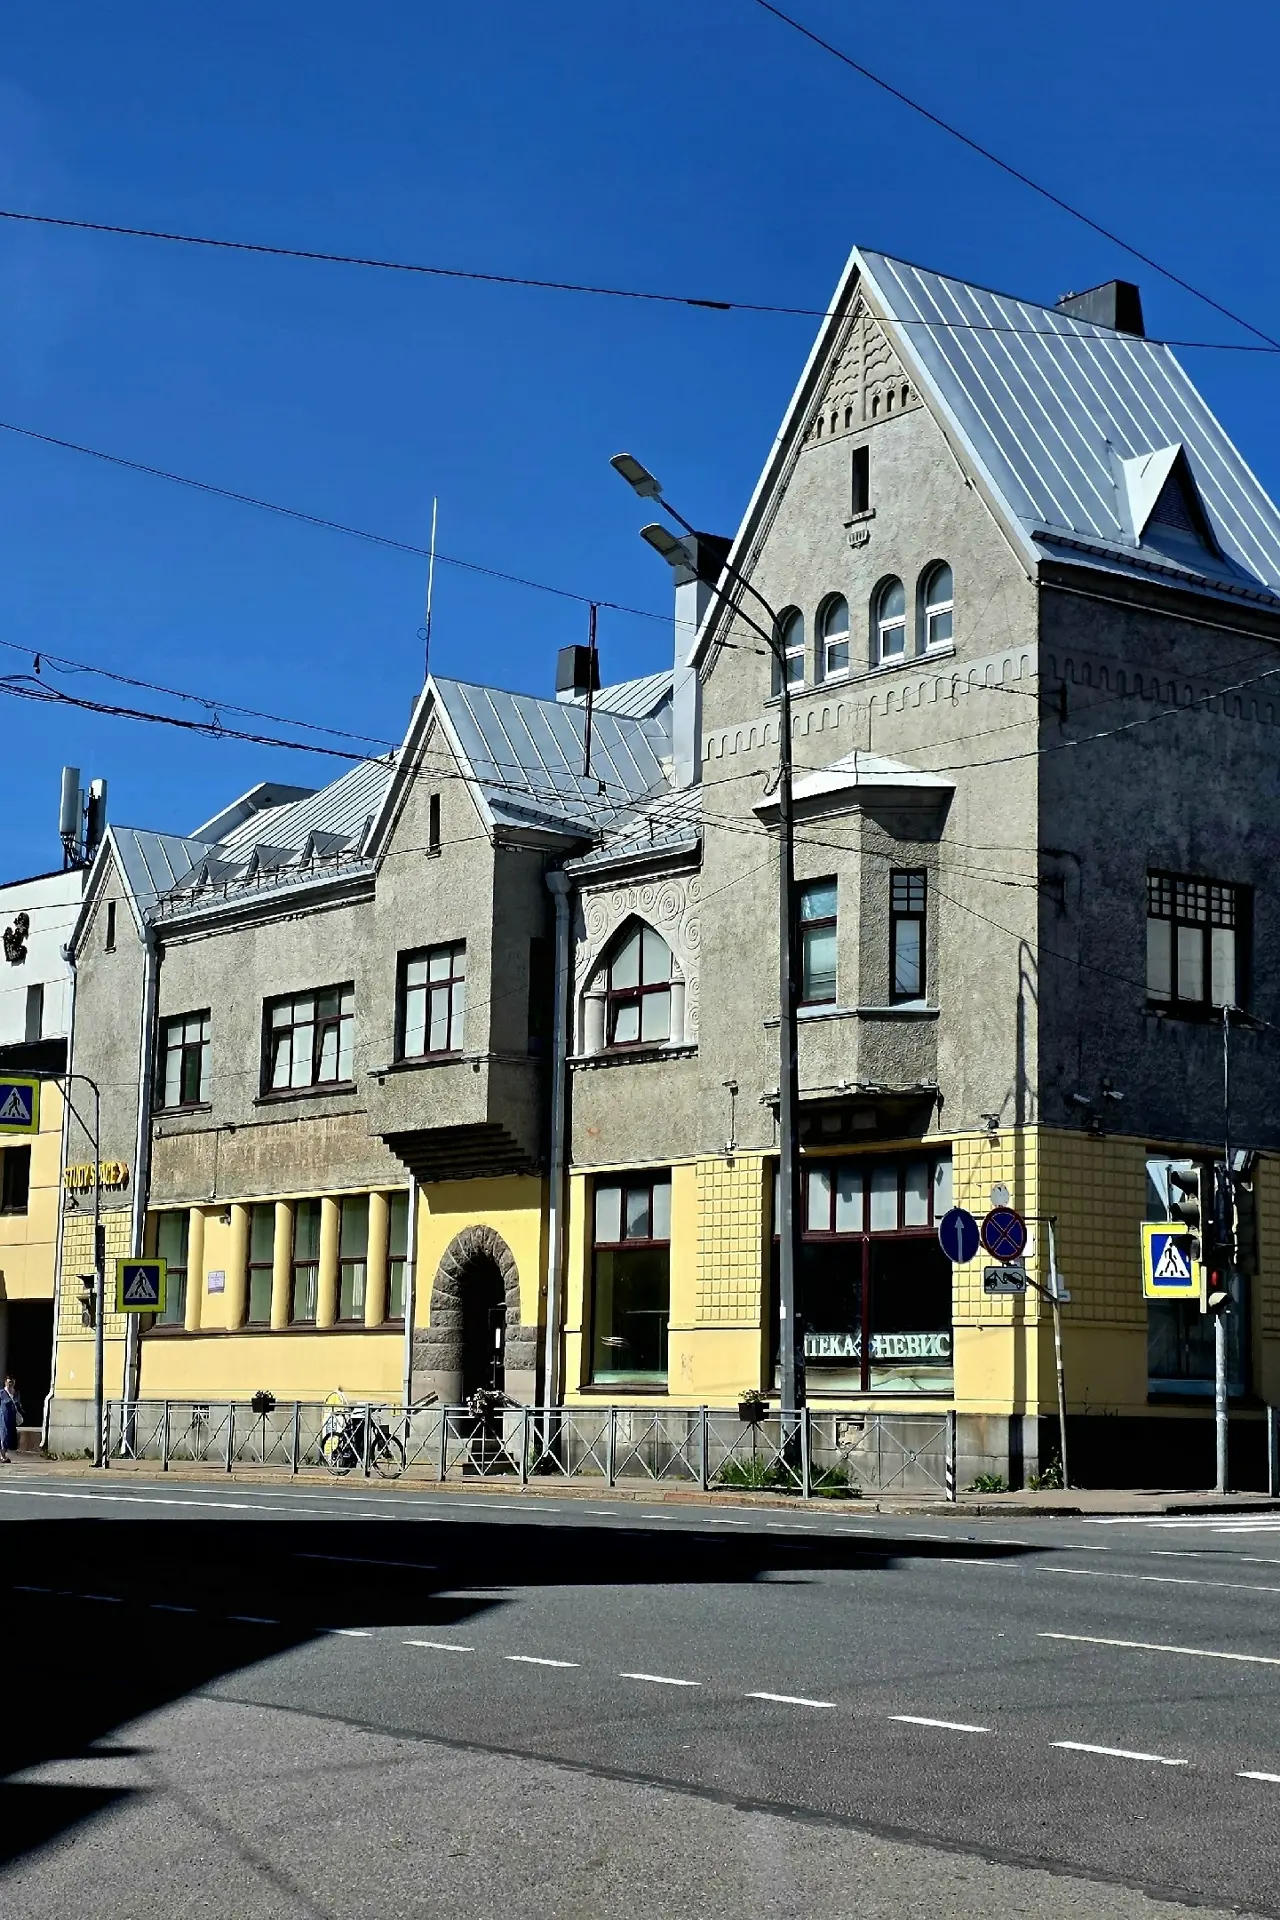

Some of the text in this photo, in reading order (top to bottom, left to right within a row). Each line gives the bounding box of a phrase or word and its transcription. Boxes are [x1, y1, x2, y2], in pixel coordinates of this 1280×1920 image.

[64, 1162, 116, 1188] STUDY SACE
[803, 1333, 950, 1358] ТЕКА НЕВИС
